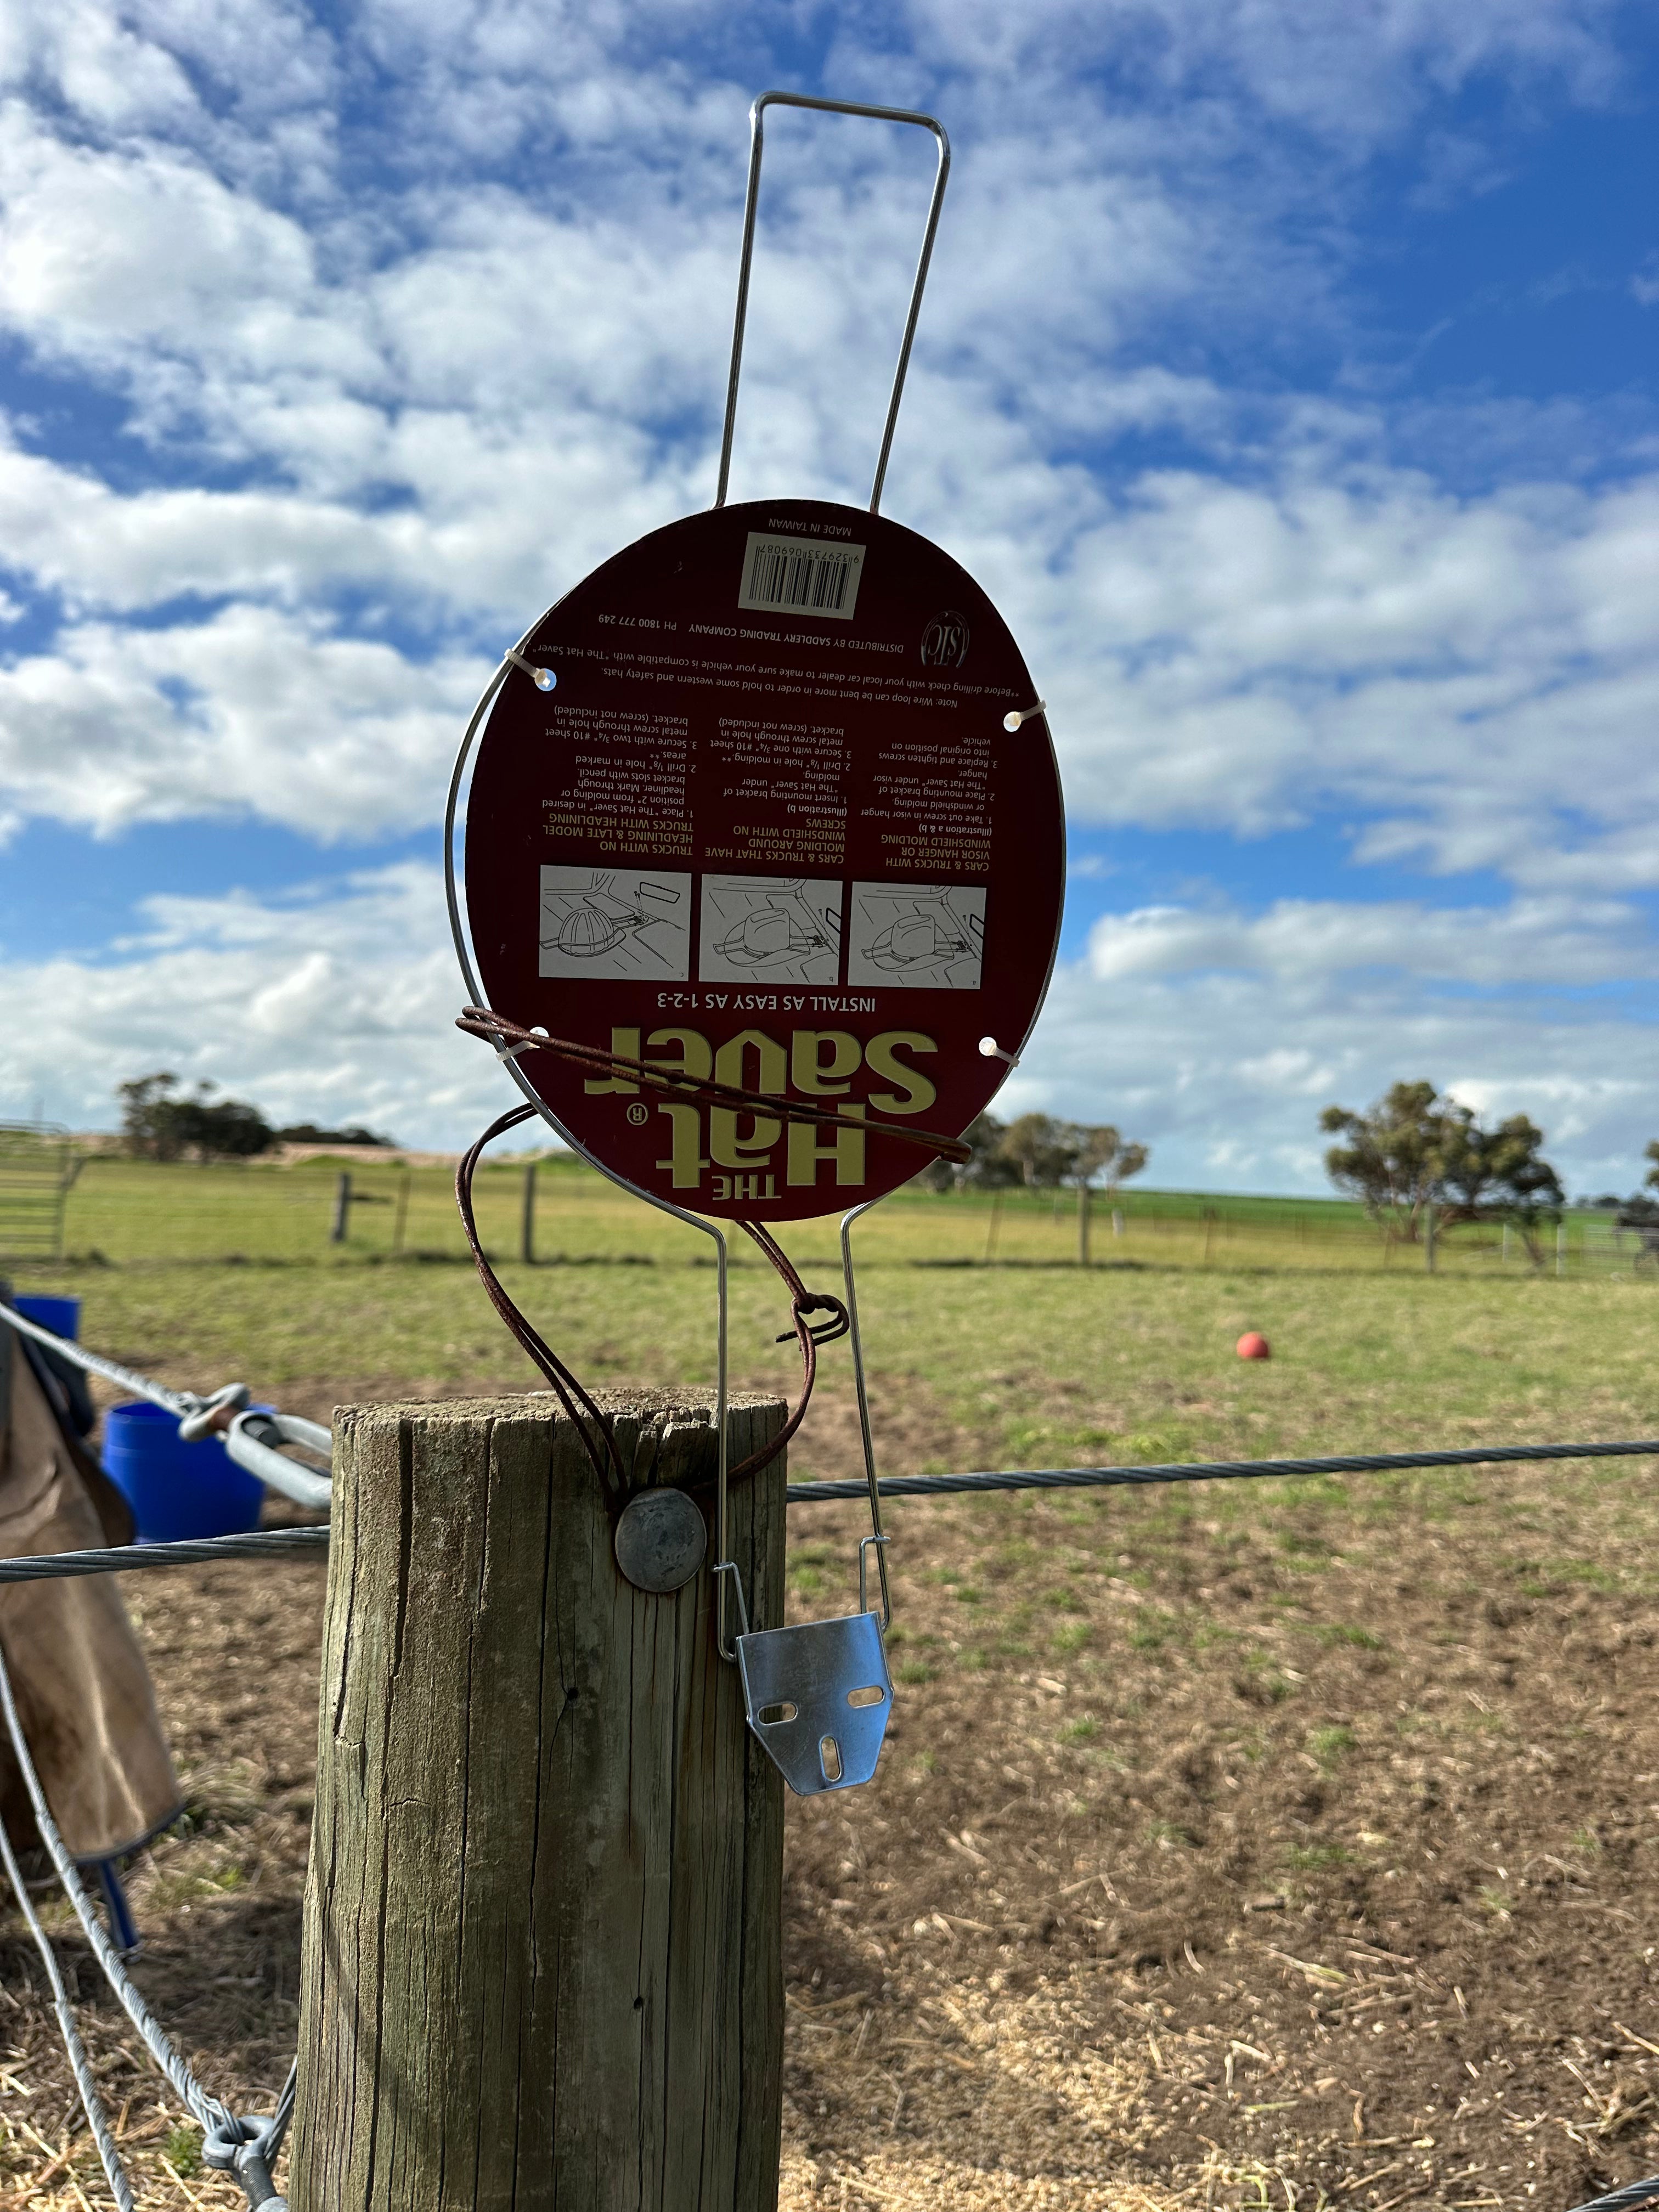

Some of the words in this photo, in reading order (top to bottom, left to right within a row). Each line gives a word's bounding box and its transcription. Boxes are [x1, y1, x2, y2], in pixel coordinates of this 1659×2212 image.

[769, 518, 807, 532] TAIWAN
[810, 523, 820, 533] IN
[823, 525, 852, 537] MADE
[759, 544, 802, 557] 069087
[807, 549, 849, 562] 329733
[599, 614, 616, 624] 249
[618, 616, 636, 627] 777
[639, 618, 660, 629] 1800
[664, 620, 677, 630] PH
[689, 624, 737, 637] COMPANY
[740, 629, 781, 641] TRADING
[783, 634, 831, 646] SADDLERY
[833, 639, 845, 648] BY
[848, 640, 904, 653] DISTRIBUTED
[567, 647, 584, 657] Hat
[613, 652, 635, 662] with
[637, 654, 689, 666] compatible
[701, 661, 732, 672] vehicle
[735, 663, 756, 673] your
[601, 668, 623, 679] hats.
[626, 668, 654, 681] safety
[657, 673, 674, 682] and
[779, 668, 804, 678] make
[817, 672, 845, 683] dealer
[677, 675, 713, 685] western
[716, 679, 740, 687] some
[862, 676, 883, 686] local
[884, 678, 905, 686] your
[906, 680, 926, 689] with
[742, 681, 762, 692] hold
[777, 685, 802, 694] order
[814, 687, 837, 696] more
[928, 682, 951, 692] check
[953, 682, 983, 695] drilling
[840, 690, 860, 701] bent
[892, 693, 911, 705] loop
[913, 696, 933, 706] Wire
[935, 698, 958, 708] Note:
[554, 705, 597, 719] included)
[619, 712, 649, 724] (screw
[652, 715, 689, 727] bracket.
[719, 717, 760, 730] included)
[569, 719, 589, 730] hole
[592, 719, 630, 733] through
[633, 725, 659, 733] screw
[780, 724, 807, 735] (screw
[545, 728, 571, 739] sheet
[662, 727, 687, 736] metal
[732, 730, 752, 741] hole
[754, 731, 790, 743] through
[810, 726, 844, 737] bracket.
[613, 735, 631, 743] two
[634, 736, 654, 746] with
[657, 738, 687, 749] Secure
[792, 736, 817, 744] screw
[819, 738, 843, 747] metal
[961, 737, 991, 747] vehicle.
[710, 740, 734, 750] sheet
[793, 746, 812, 755] with
[905, 743, 938, 753] position
[940, 746, 972, 755] original
[814, 748, 842, 758] Secure
[878, 752, 905, 761] screws
[973, 749, 990, 758] into
[575, 755, 611, 765] marked
[625, 759, 645, 770] hole
[782, 758, 803, 768] hole
[907, 754, 938, 765] tighten
[940, 757, 956, 765] and
[957, 758, 989, 768] Replace
[667, 763, 686, 772] Drill
[823, 761, 841, 771] Drill
[577, 768, 606, 778] pencil.
[609, 771, 629, 781] with
[631, 772, 651, 783] slots
[803, 770, 840, 782] molding.
[958, 769, 988, 781] hanger.
[578, 778, 614, 791] through
[653, 774, 685, 786] bracket
[742, 778, 768, 788] under
[873, 775, 893, 784] visor
[894, 776, 919, 786] under
[950, 780, 964, 789] Hat
[617, 783, 640, 793] Mark
[642, 785, 685, 796] headliner.
[800, 782, 816, 792] Hat
[890, 787, 921, 797] bracket
[923, 787, 963, 797] mounting
[573, 788, 610, 801] molding
[613, 793, 634, 804] from
[735, 788, 768, 799] bracket
[770, 789, 812, 800] mounting
[814, 794, 838, 804] Insert
[965, 792, 986, 800] Place
[542, 799, 575, 810] desired
[650, 796, 684, 806] position
[891, 797, 928, 809] molding.
[930, 801, 974, 811] windshield
[620, 805, 636, 815] Hat
[662, 808, 684, 818] Place
[798, 805, 848, 817] (Illustration
[860, 807, 890, 819] hanger
[892, 811, 911, 820] visor
[549, 813, 617, 827] HEADLINING
[621, 818, 650, 829] WITH
[806, 818, 846, 830] SCREWS
[965, 815, 984, 824] Take
[543, 825, 583, 837] MODEL
[652, 820, 694, 832] TRUCKS
[733, 826, 749, 836] NO
[946, 826, 992, 837] (Illustration
[587, 828, 612, 839] LATE
[628, 830, 693, 844] HEADLINING
[752, 827, 780, 837] WITH
[782, 828, 845, 841] WINDSHIELD
[748, 838, 794, 850] AROUND
[881, 834, 928, 845] MOLDING
[931, 837, 991, 849] WINDSHIELD
[600, 841, 617, 851] NO
[620, 842, 649, 853] WITH
[652, 844, 693, 855] TRUCKS
[797, 841, 844, 853] MOLDING
[901, 847, 916, 856] OR
[705, 847, 733, 858] HAVE
[736, 849, 763, 860] THAT
[765, 851, 805, 862] TRUCKS
[918, 848, 958, 859] HANGER
[962, 850, 990, 860] VISOR
[818, 854, 844, 864] CARS
[885, 857, 911, 867] WITH
[915, 859, 952, 870] TRUCKS
[964, 861, 989, 871] CARS
[657, 992, 698, 1008] 1-2-3
[705, 994, 729, 1009] AS
[732, 995, 777, 1010] EASY
[783, 996, 805, 1011] AS
[809, 996, 876, 1012] INSTALL
[584, 1027, 939, 1114] Saver
[656, 1103, 866, 1189] Hat
[711, 1174, 782, 1201] THE
